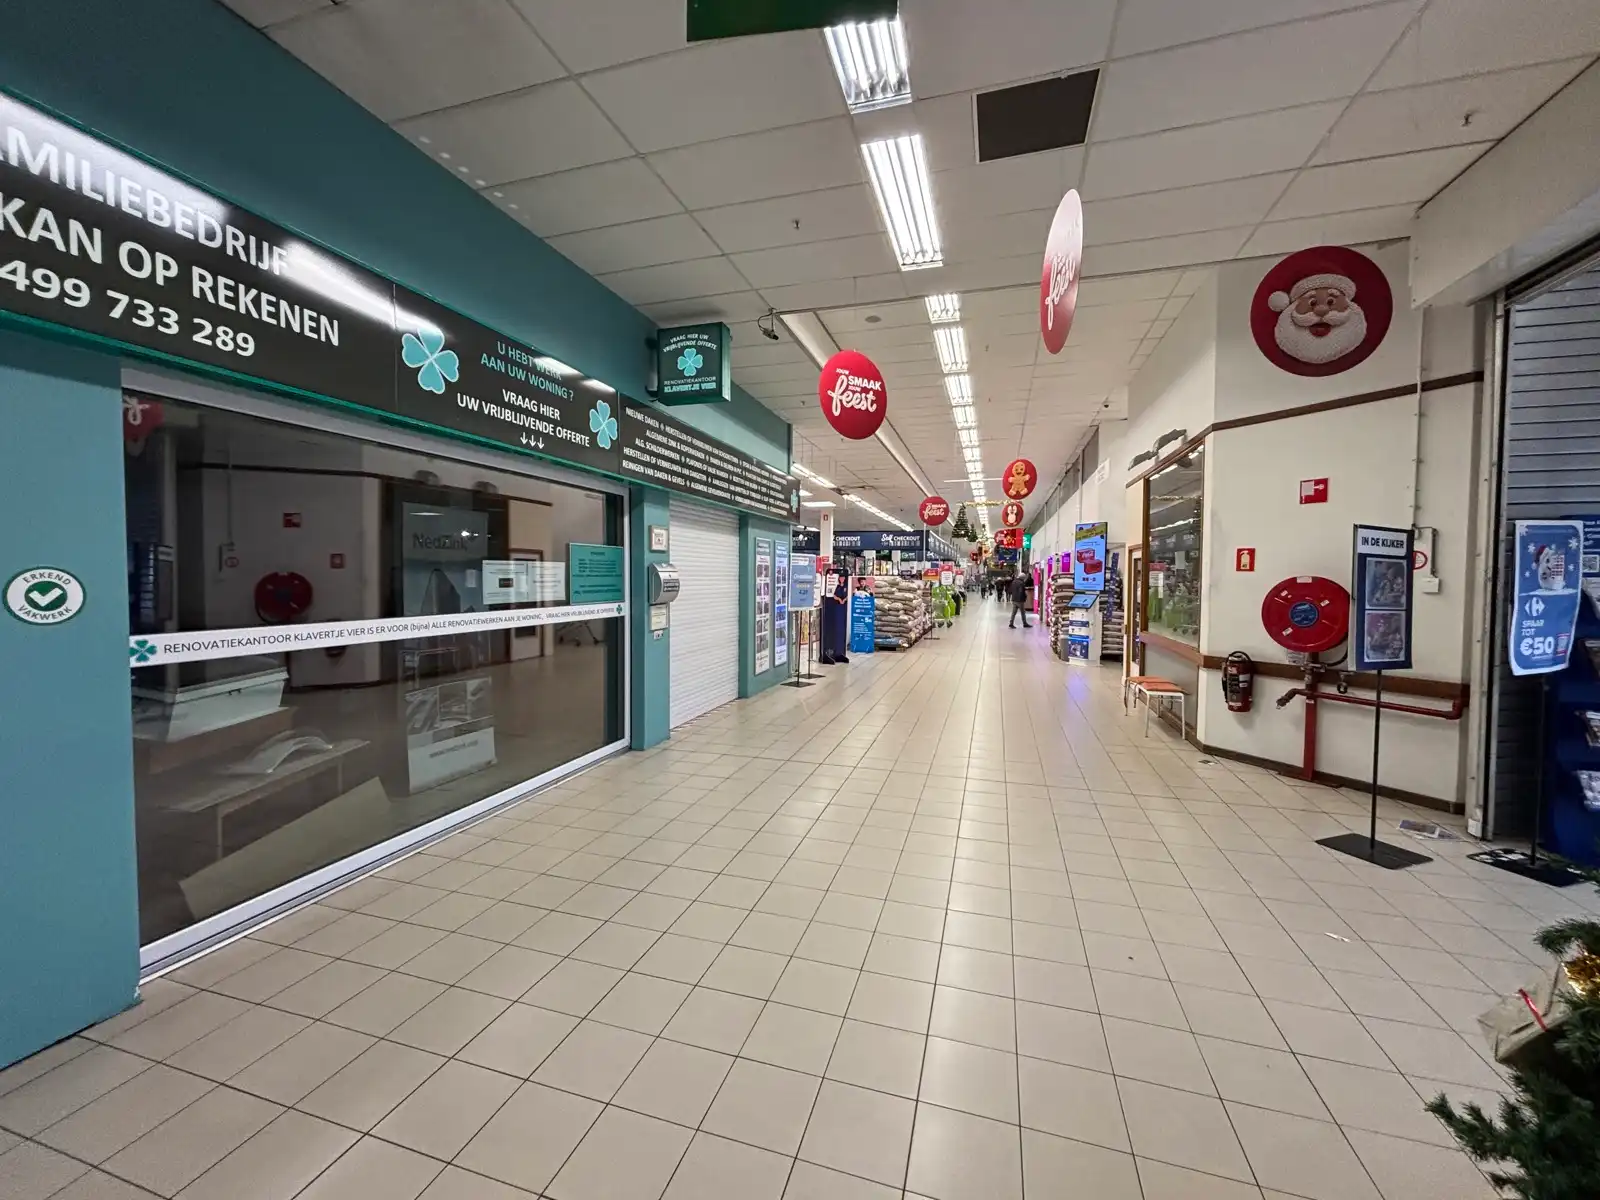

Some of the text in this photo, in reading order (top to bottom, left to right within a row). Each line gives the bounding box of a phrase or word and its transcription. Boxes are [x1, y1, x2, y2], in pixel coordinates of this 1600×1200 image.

[0, 126, 289, 276] MILIEBEDRIJF
[0, 192, 339, 346] KAN OP REKENEN
[0, 260, 255, 357] 499 733 289
[670, 335, 686, 343] VRAAG
[697, 340, 718, 350] OFFERTE
[497, 341, 506, 355] U
[508, 346, 534, 368] HEBT
[481, 353, 505, 374] AAN
[508, 363, 526, 382] UW
[528, 372, 568, 399] WONING
[848, 375, 882, 391] SMAAK
[502, 389, 561, 421] VRAAG HIER
[827, 375, 877, 416] feest
[457, 393, 590, 447] UW VRIJBLIJVENDE OFFERTE
[623, 446, 651, 463] HERSTELLEN
[622, 459, 644, 474] REINIGEN
[644, 467, 654, 477] VAN
[1361, 536, 1404, 549] IN DE KIJKER
[22, 572, 71, 585] ERKEND
[18, 604, 72, 620] VAKWERK
[164, 633, 292, 653] RENOVATIEKANTOOR
[294, 628, 346, 642] KLAVERTJE
[347, 626, 366, 637] VIER
[367, 626, 374, 635] IS
[375, 625, 386, 634] ER
[387, 623, 409, 633] VOOR
[410, 621, 430, 632] (bijna)
[431, 620, 446, 629] ALLE
[448, 615, 503, 627] RENOVATIEWERKEN
[503, 615, 515, 623] AAN
[1521, 628, 1536, 636] TOT
[1520, 636, 1555, 656] €50
